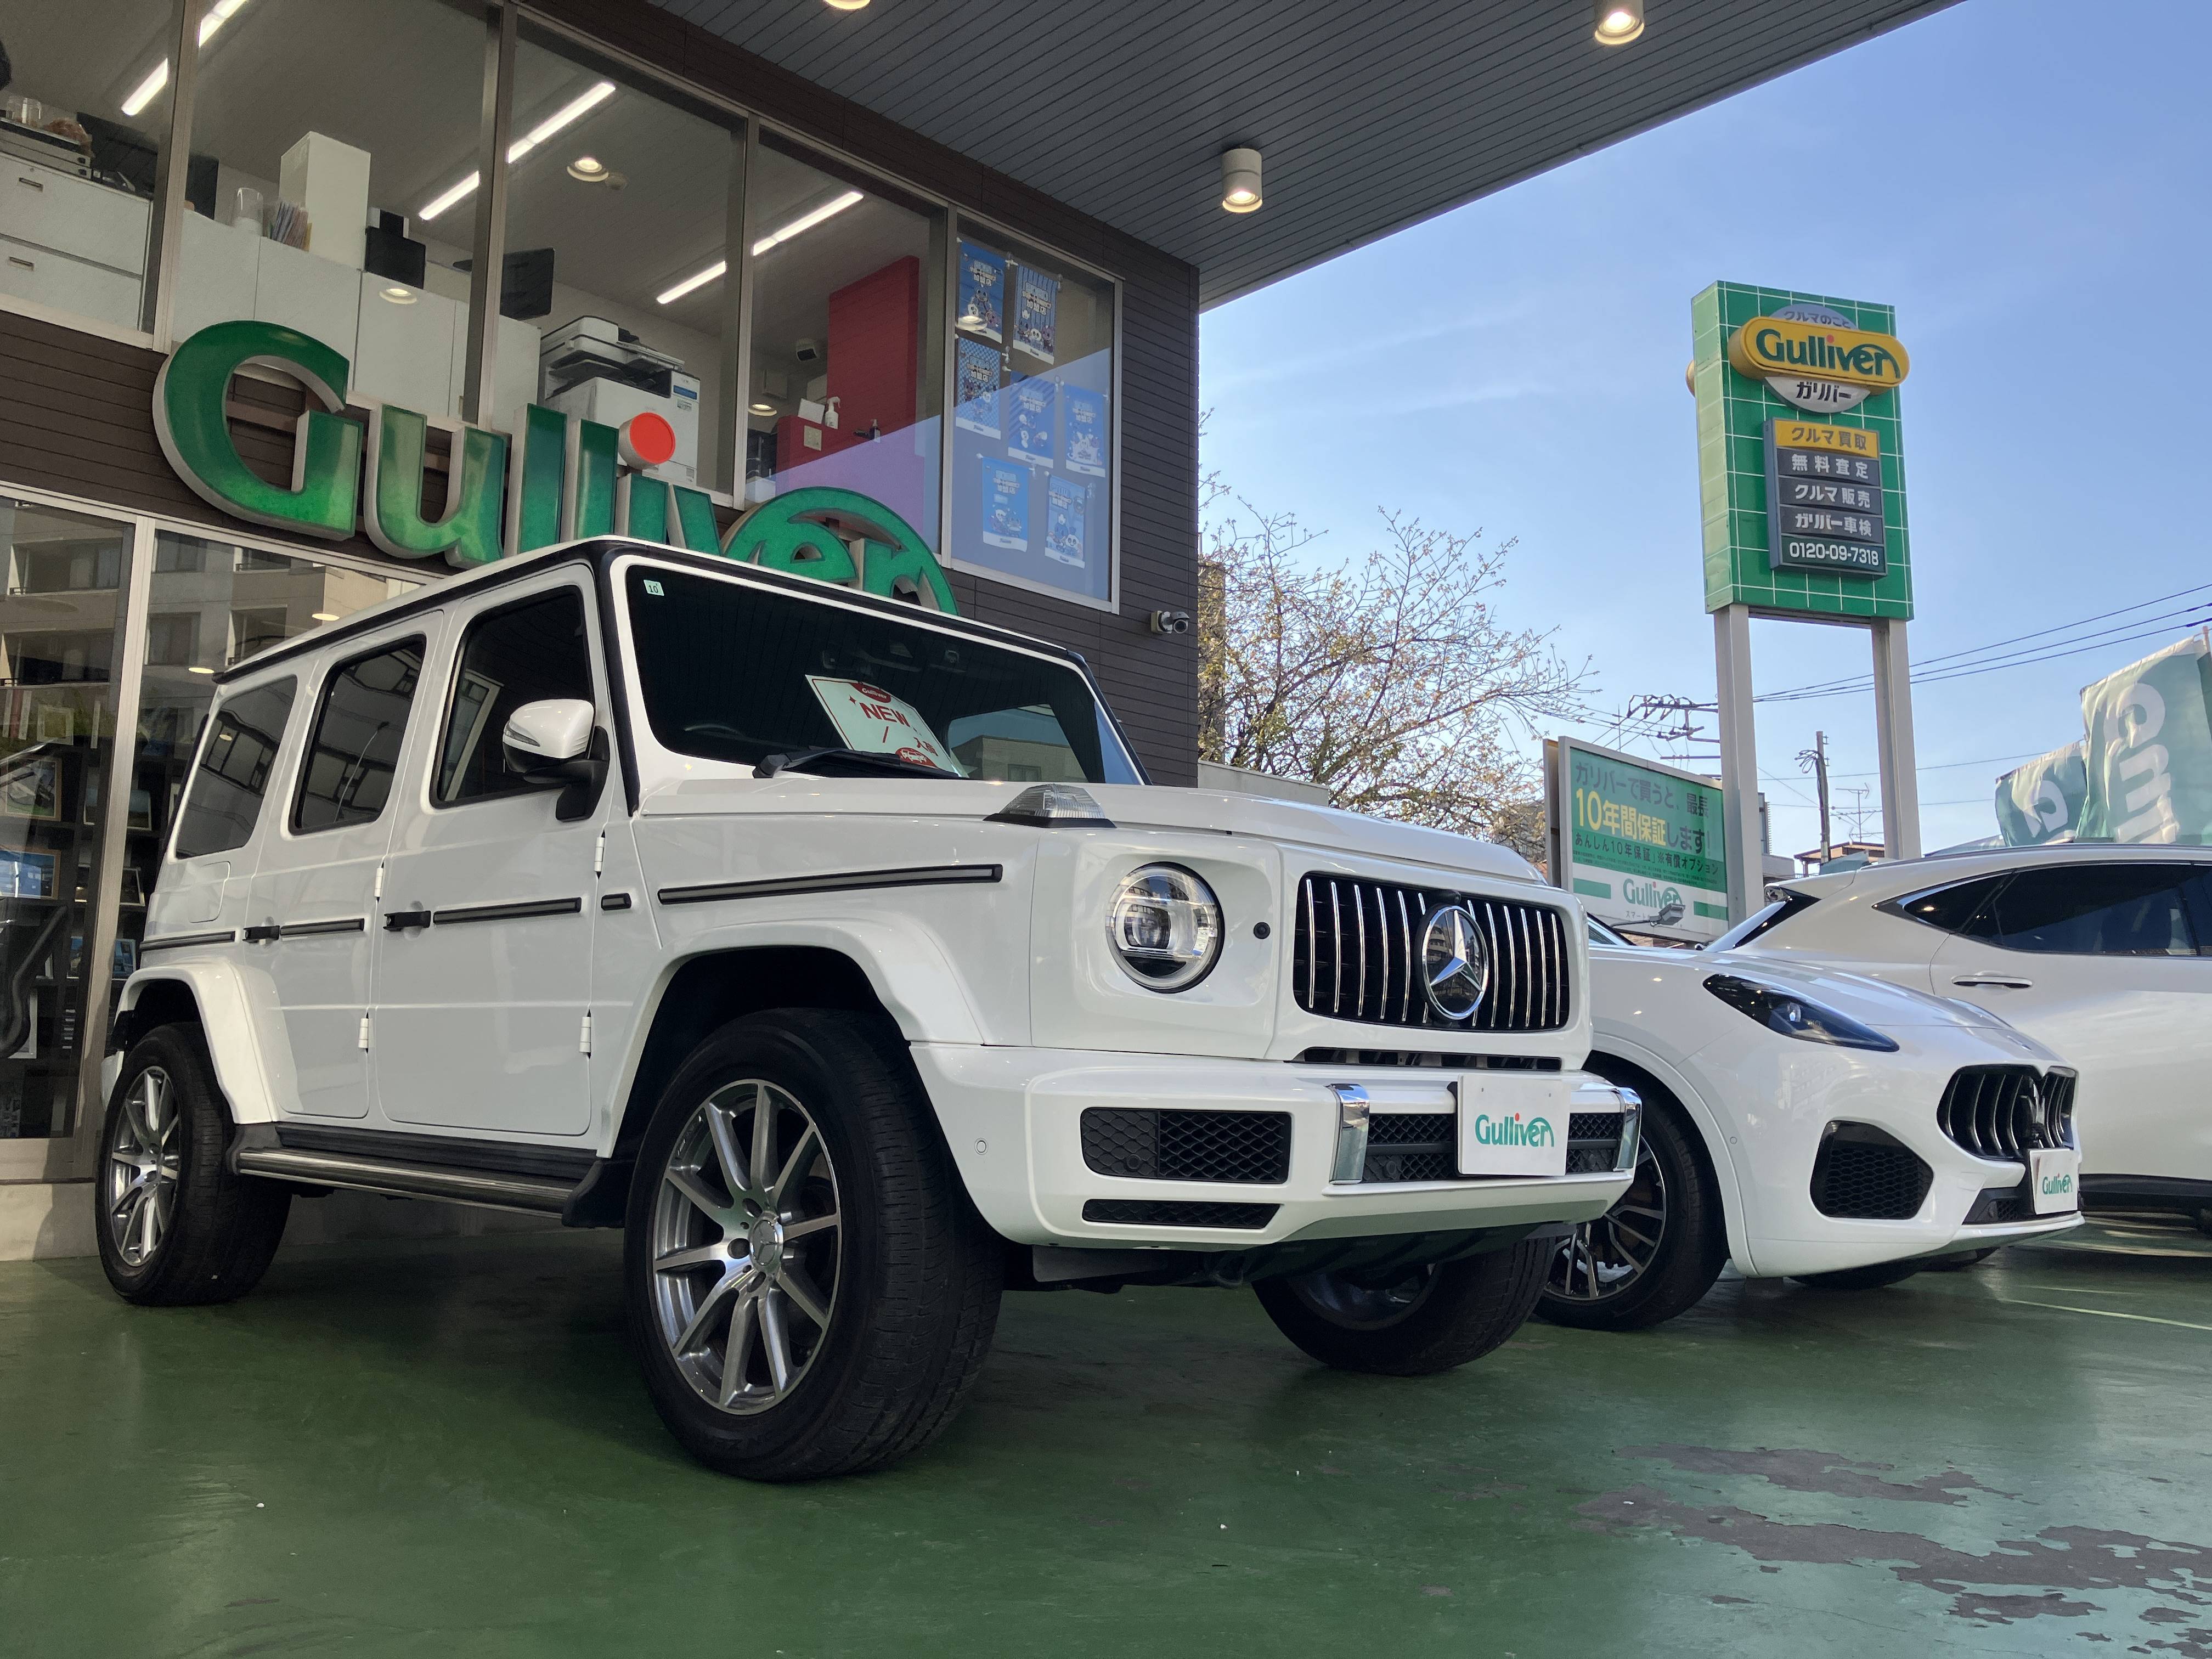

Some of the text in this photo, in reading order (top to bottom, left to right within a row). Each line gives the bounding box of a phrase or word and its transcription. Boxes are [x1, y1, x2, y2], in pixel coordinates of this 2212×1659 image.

[1784, 311, 1851, 329] クルマのこと
[1756, 329, 1901, 378] Gulliver
[1796, 381, 1852, 403] ガリバー
[1792, 427, 1866, 450] クルマ買取
[1792, 454, 1869, 479] 無料査定
[1795, 484, 1870, 508] クルマ販売
[1795, 513, 1872, 537] ガリバー車検
[1789, 541, 1879, 566] 0120-09-7318
[649, 585, 658, 594] 10
[862, 687, 887, 699] Gulliver
[859, 702, 911, 727] NEW
[1623, 878, 1683, 909] Gulliver
[1475, 1113, 1554, 1147] Gulliver
[2042, 1173, 2073, 1195] Gulliver
